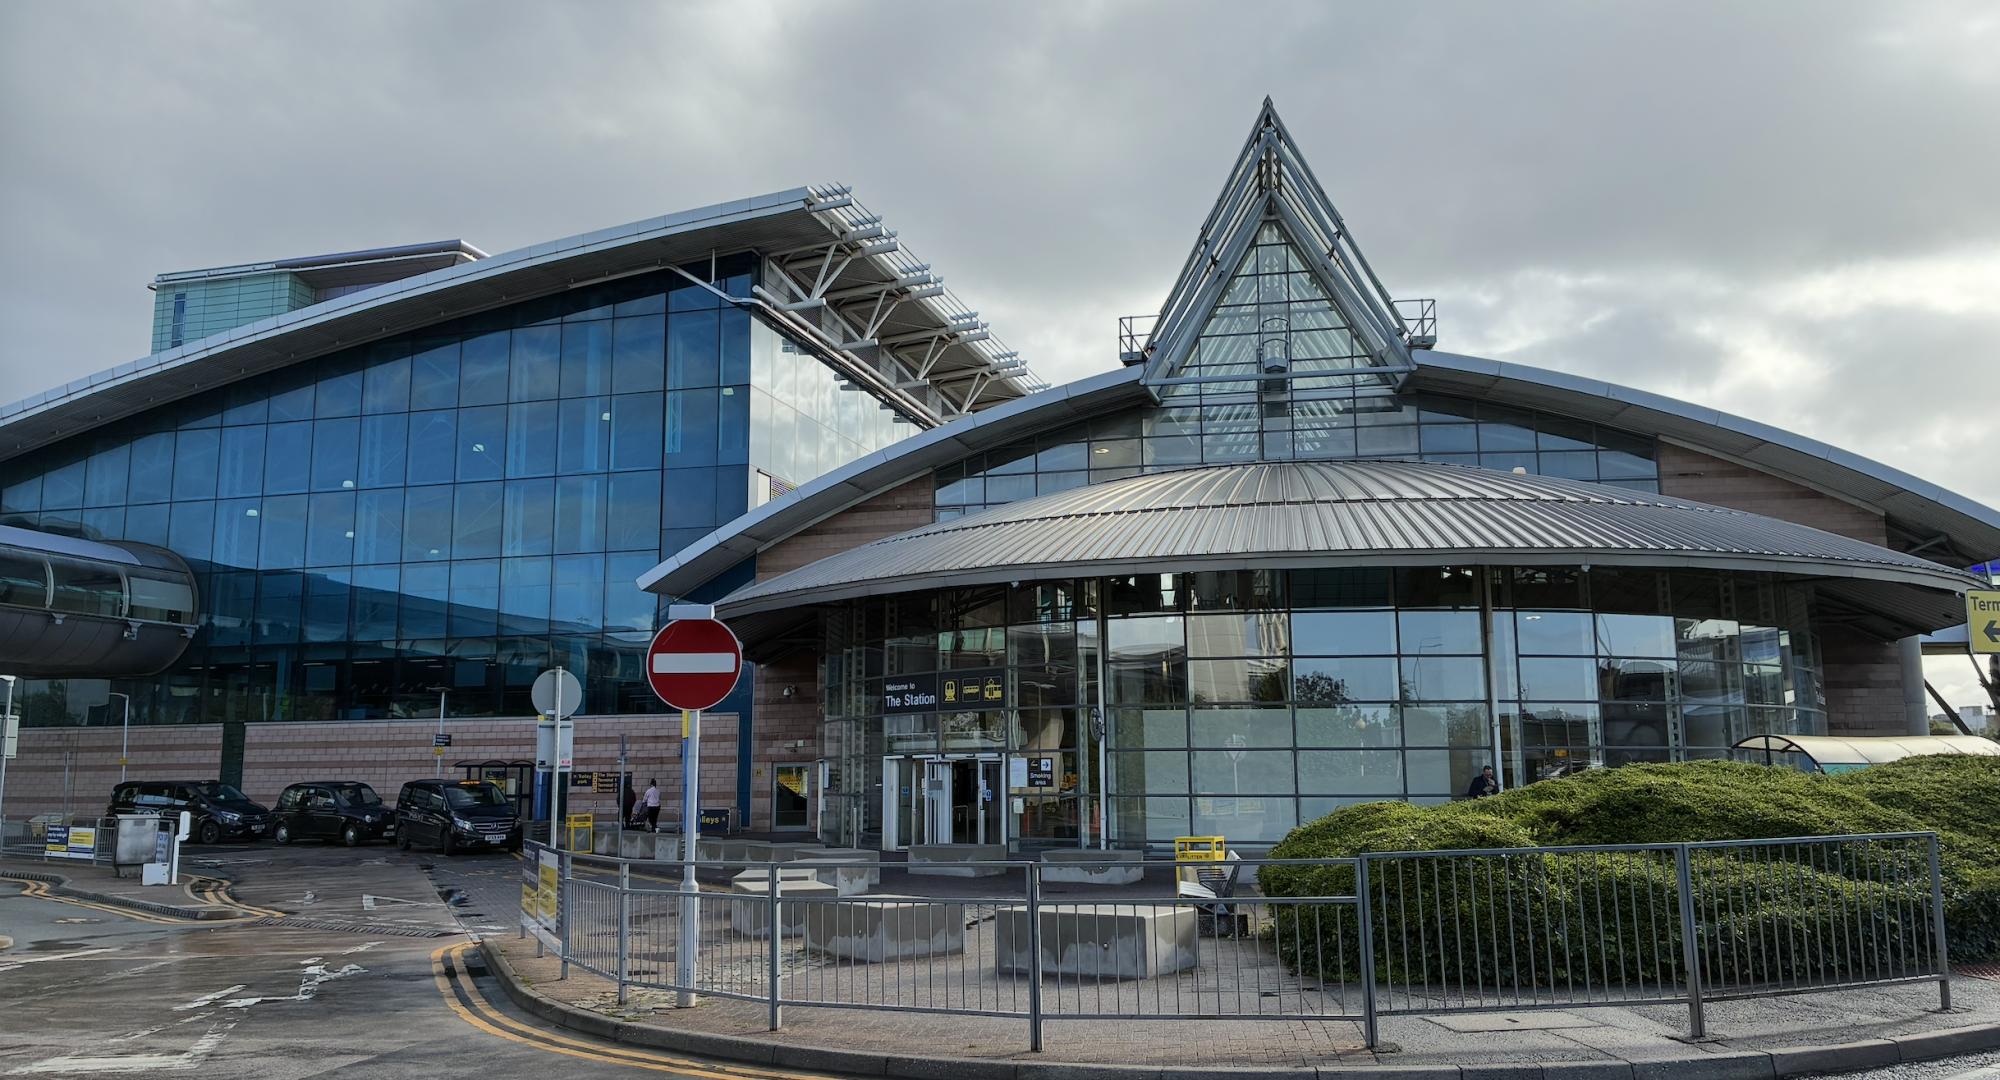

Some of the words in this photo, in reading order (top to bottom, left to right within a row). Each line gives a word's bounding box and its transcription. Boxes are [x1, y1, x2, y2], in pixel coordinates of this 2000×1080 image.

[886, 683, 908, 691] Welcome
[909, 682, 916, 690] to
[885, 695, 901, 707] The
[904, 693, 936, 706] Station
